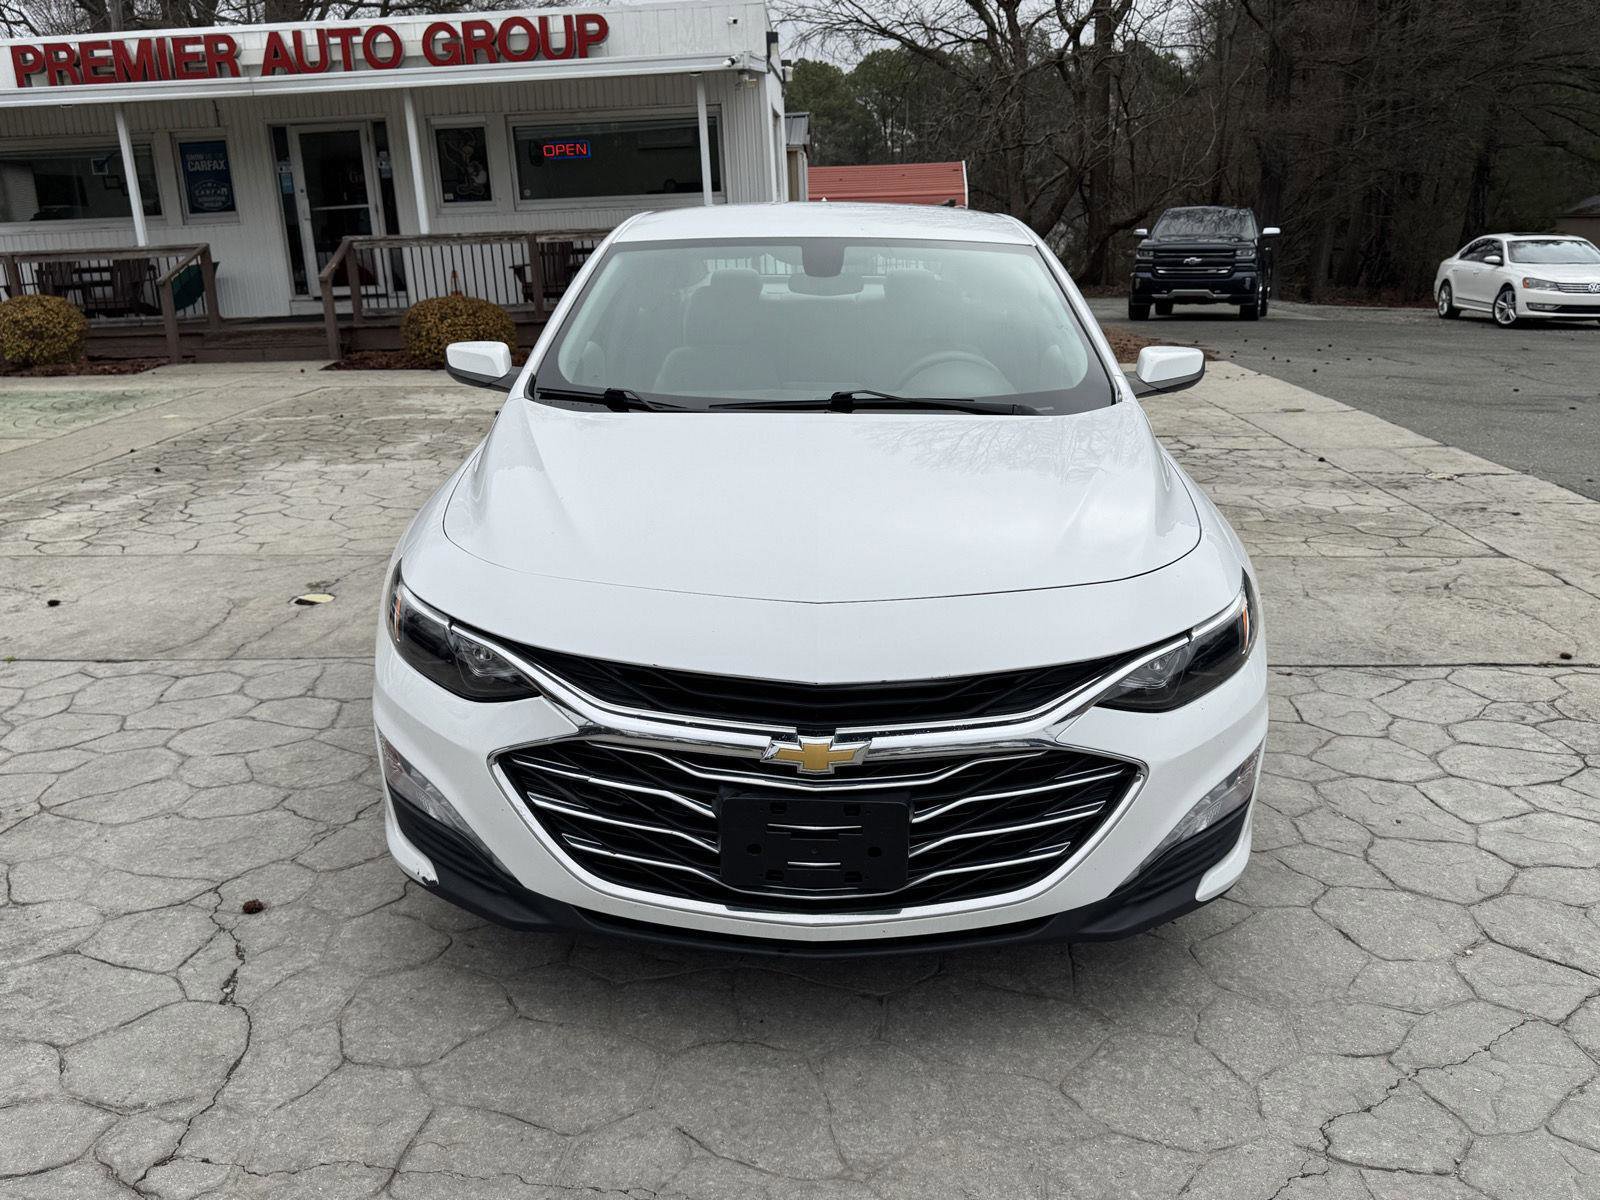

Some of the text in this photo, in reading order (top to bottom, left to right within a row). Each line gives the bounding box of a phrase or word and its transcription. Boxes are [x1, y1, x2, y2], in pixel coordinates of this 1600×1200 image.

[11, 14, 608, 87] PREMIER AUTO GROUP
[543, 143, 587, 157] OPEN
[187, 160, 227, 171] CARFAX
